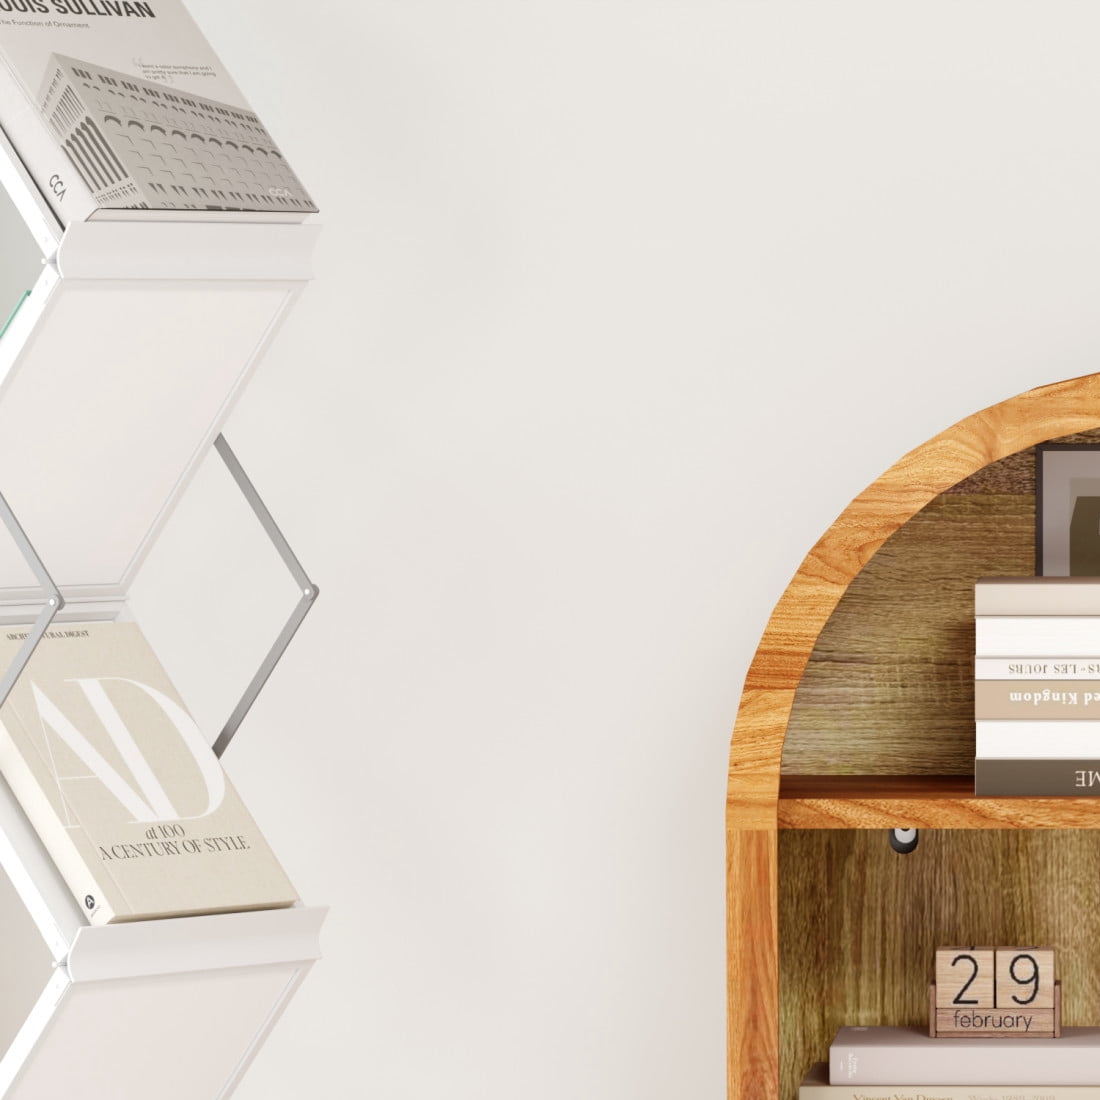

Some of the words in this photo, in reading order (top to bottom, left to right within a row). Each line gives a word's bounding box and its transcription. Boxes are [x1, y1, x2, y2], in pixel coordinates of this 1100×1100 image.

[0, 0, 49, 13] OUIS
[50, 0, 156, 18] SULLIVAN
[1008, 663, 1048, 674] JOURS
[1054, 663, 1077, 674] LES
[1009, 690, 1077, 705] Kingdom
[145, 826, 158, 840] at
[158, 824, 186, 838] 100
[98, 846, 113, 861] A
[111, 840, 182, 860] CENTURY
[182, 838, 202, 854] OF
[199, 835, 251, 852] STYLE
[953, 1009, 1033, 1032] february
